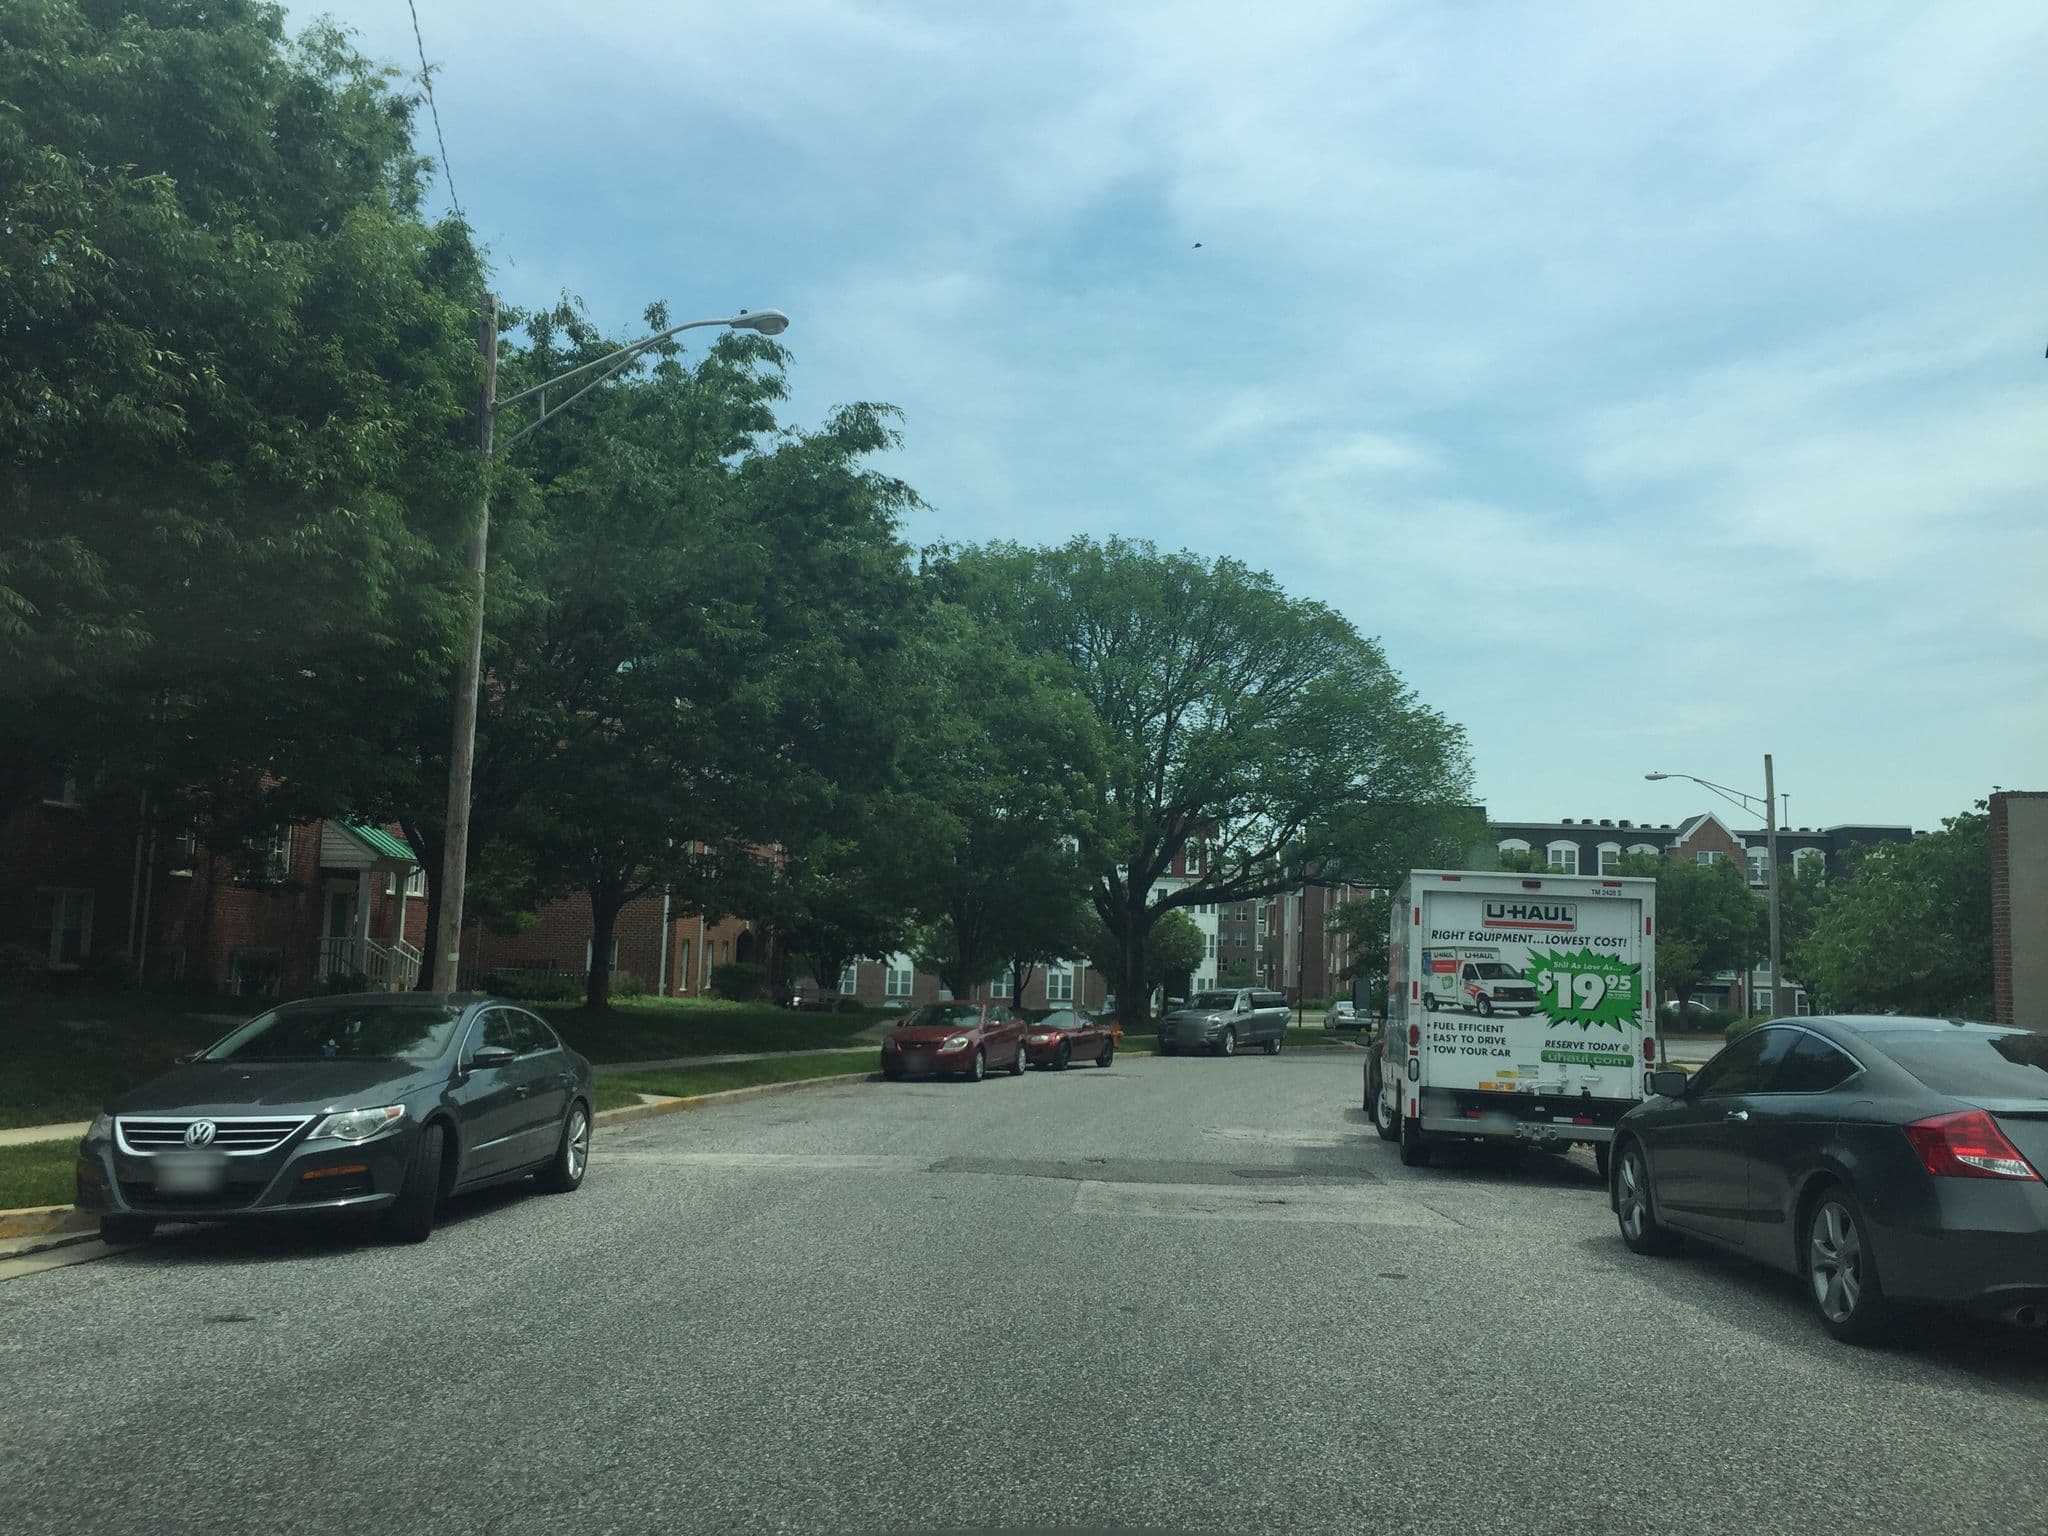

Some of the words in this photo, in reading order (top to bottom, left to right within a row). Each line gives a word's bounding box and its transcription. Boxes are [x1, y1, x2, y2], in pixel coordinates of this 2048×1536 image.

[1486, 904, 1573, 921] U-HAUL
[1431, 930, 1465, 940] RIGHT
[1593, 937, 1627, 947] COST!
[1433, 1022, 1456, 1031] FUEL
[1458, 1023, 1505, 1033] EFFICIENT
[1433, 1033, 1458, 1043] EASY
[1461, 1035, 1475, 1043] TO
[1477, 1036, 1507, 1045] DRIVE
[1432, 1045, 1457, 1054] TOW
[1460, 1047, 1488, 1056] YOUR
[1491, 1048, 1512, 1057] CAR
[1544, 1040, 1585, 1050] RESERVE
[1587, 1042, 1621, 1052] TODAY
[1547, 1053, 1627, 1066] uhaul.com
